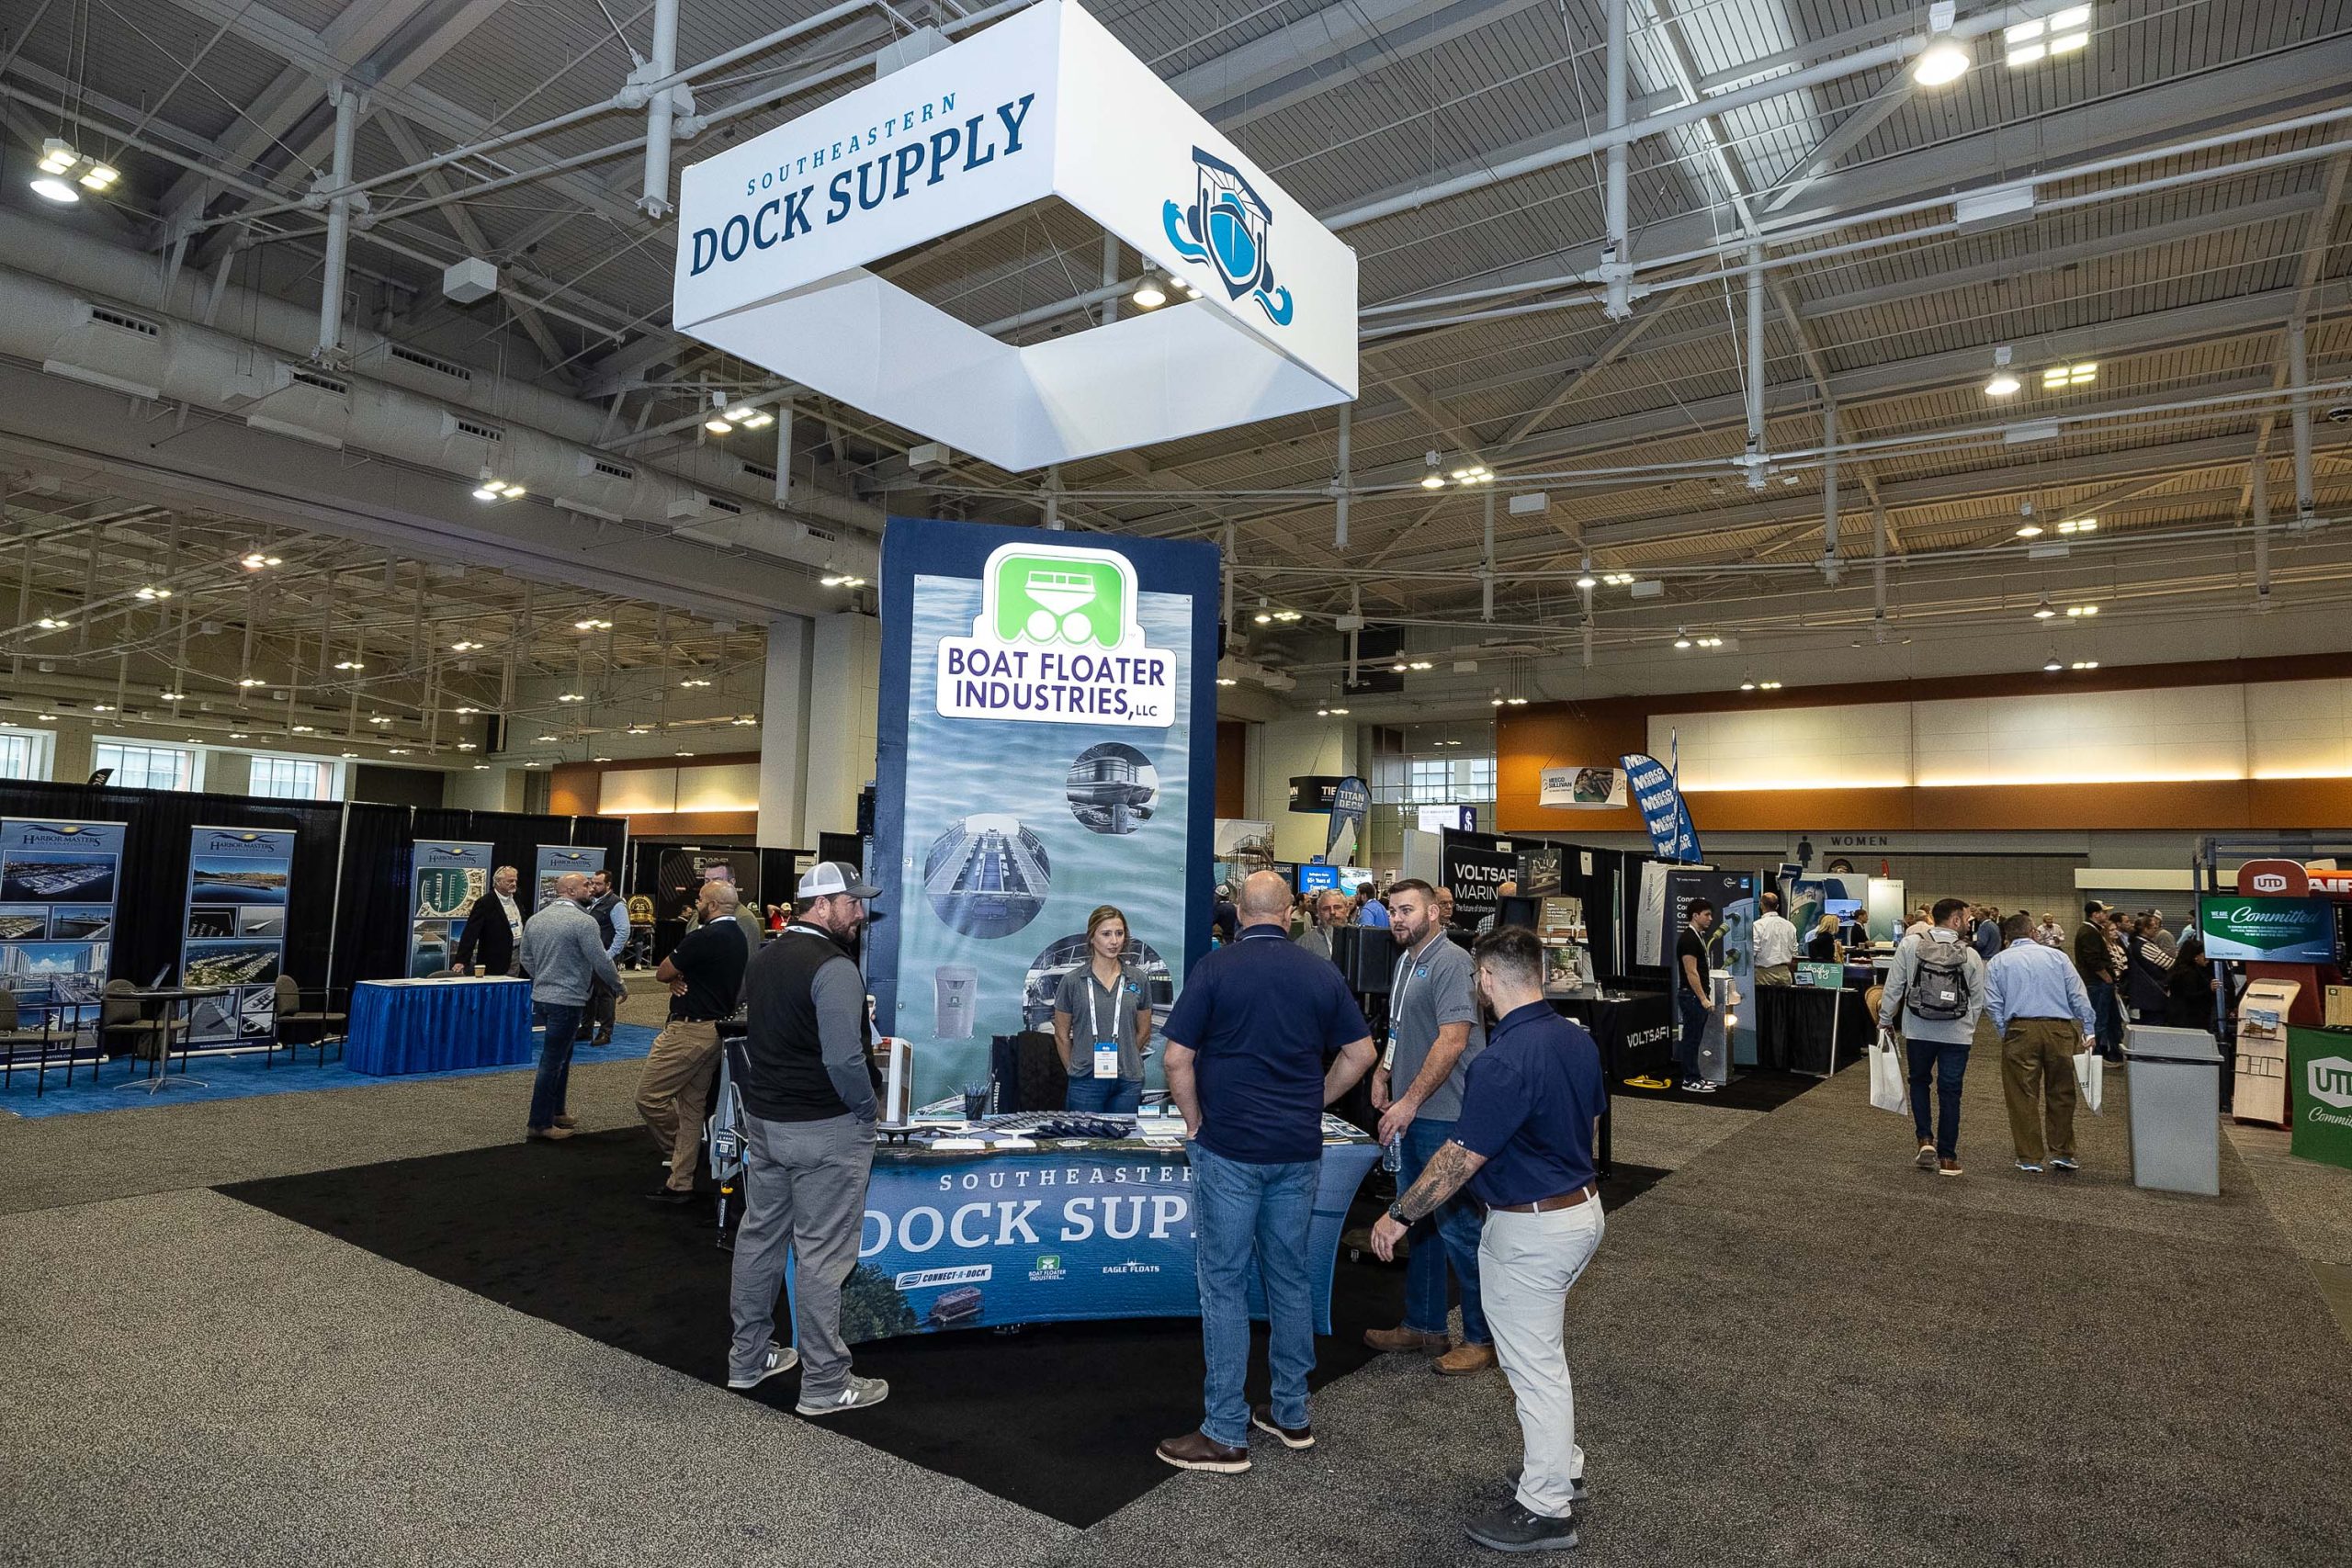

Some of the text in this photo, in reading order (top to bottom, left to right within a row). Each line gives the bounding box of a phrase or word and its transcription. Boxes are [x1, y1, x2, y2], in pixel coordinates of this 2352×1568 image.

[747, 92, 956, 197] SOUTHEASTERN
[690, 93, 1035, 276] DOCK SUPPLY
[948, 648, 1166, 686] BOAT FLOATER
[956, 680, 1158, 720] INDUSTRIES, LLC
[1339, 799, 1363, 810] DECK
[1340, 790, 1365, 802] TITAN
[23, 834, 101, 847] HARBOR MASTERS
[1831, 836, 1888, 846] WOMEN
[1454, 863, 1518, 882] VOLTSAF
[1454, 883, 1498, 900] MARIN
[2257, 878, 2283, 888] UTD
[2230, 906, 2321, 924] Committed
[1626, 1025, 1669, 1048] VOLTSAF
[939, 1166, 1193, 1191] SOUTHEASTER
[858, 1194, 1197, 1258] DOCK SUP
[1130, 1265, 1160, 1273] FLOATS
